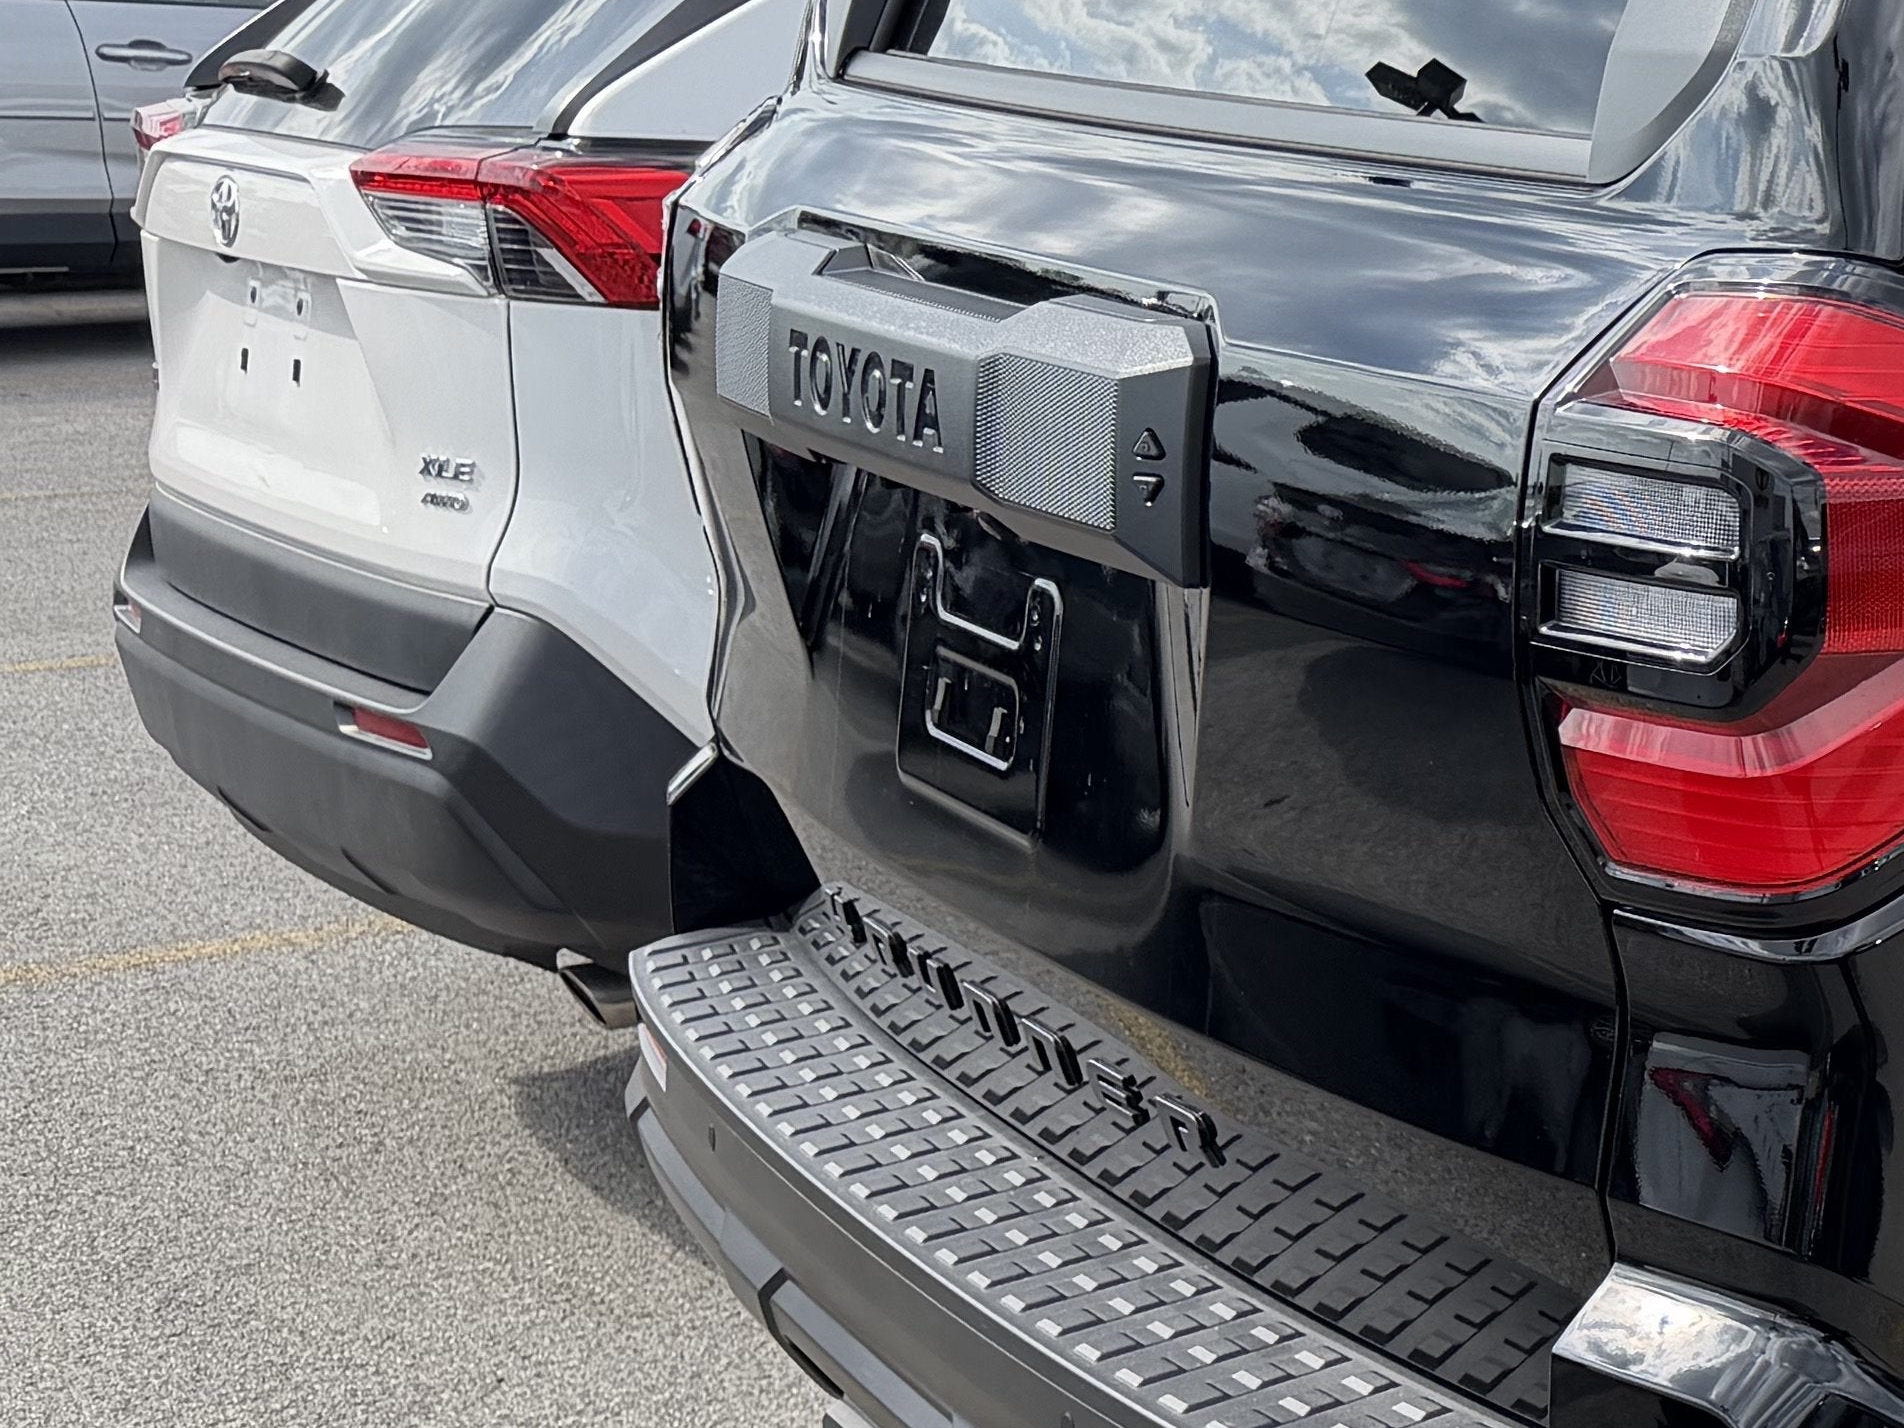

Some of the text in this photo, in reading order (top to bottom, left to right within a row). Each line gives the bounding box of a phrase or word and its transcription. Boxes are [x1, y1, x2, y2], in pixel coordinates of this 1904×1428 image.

[788, 327, 944, 454] TOYOTA
[418, 454, 476, 484] XLE
[420, 491, 471, 513] AWD
